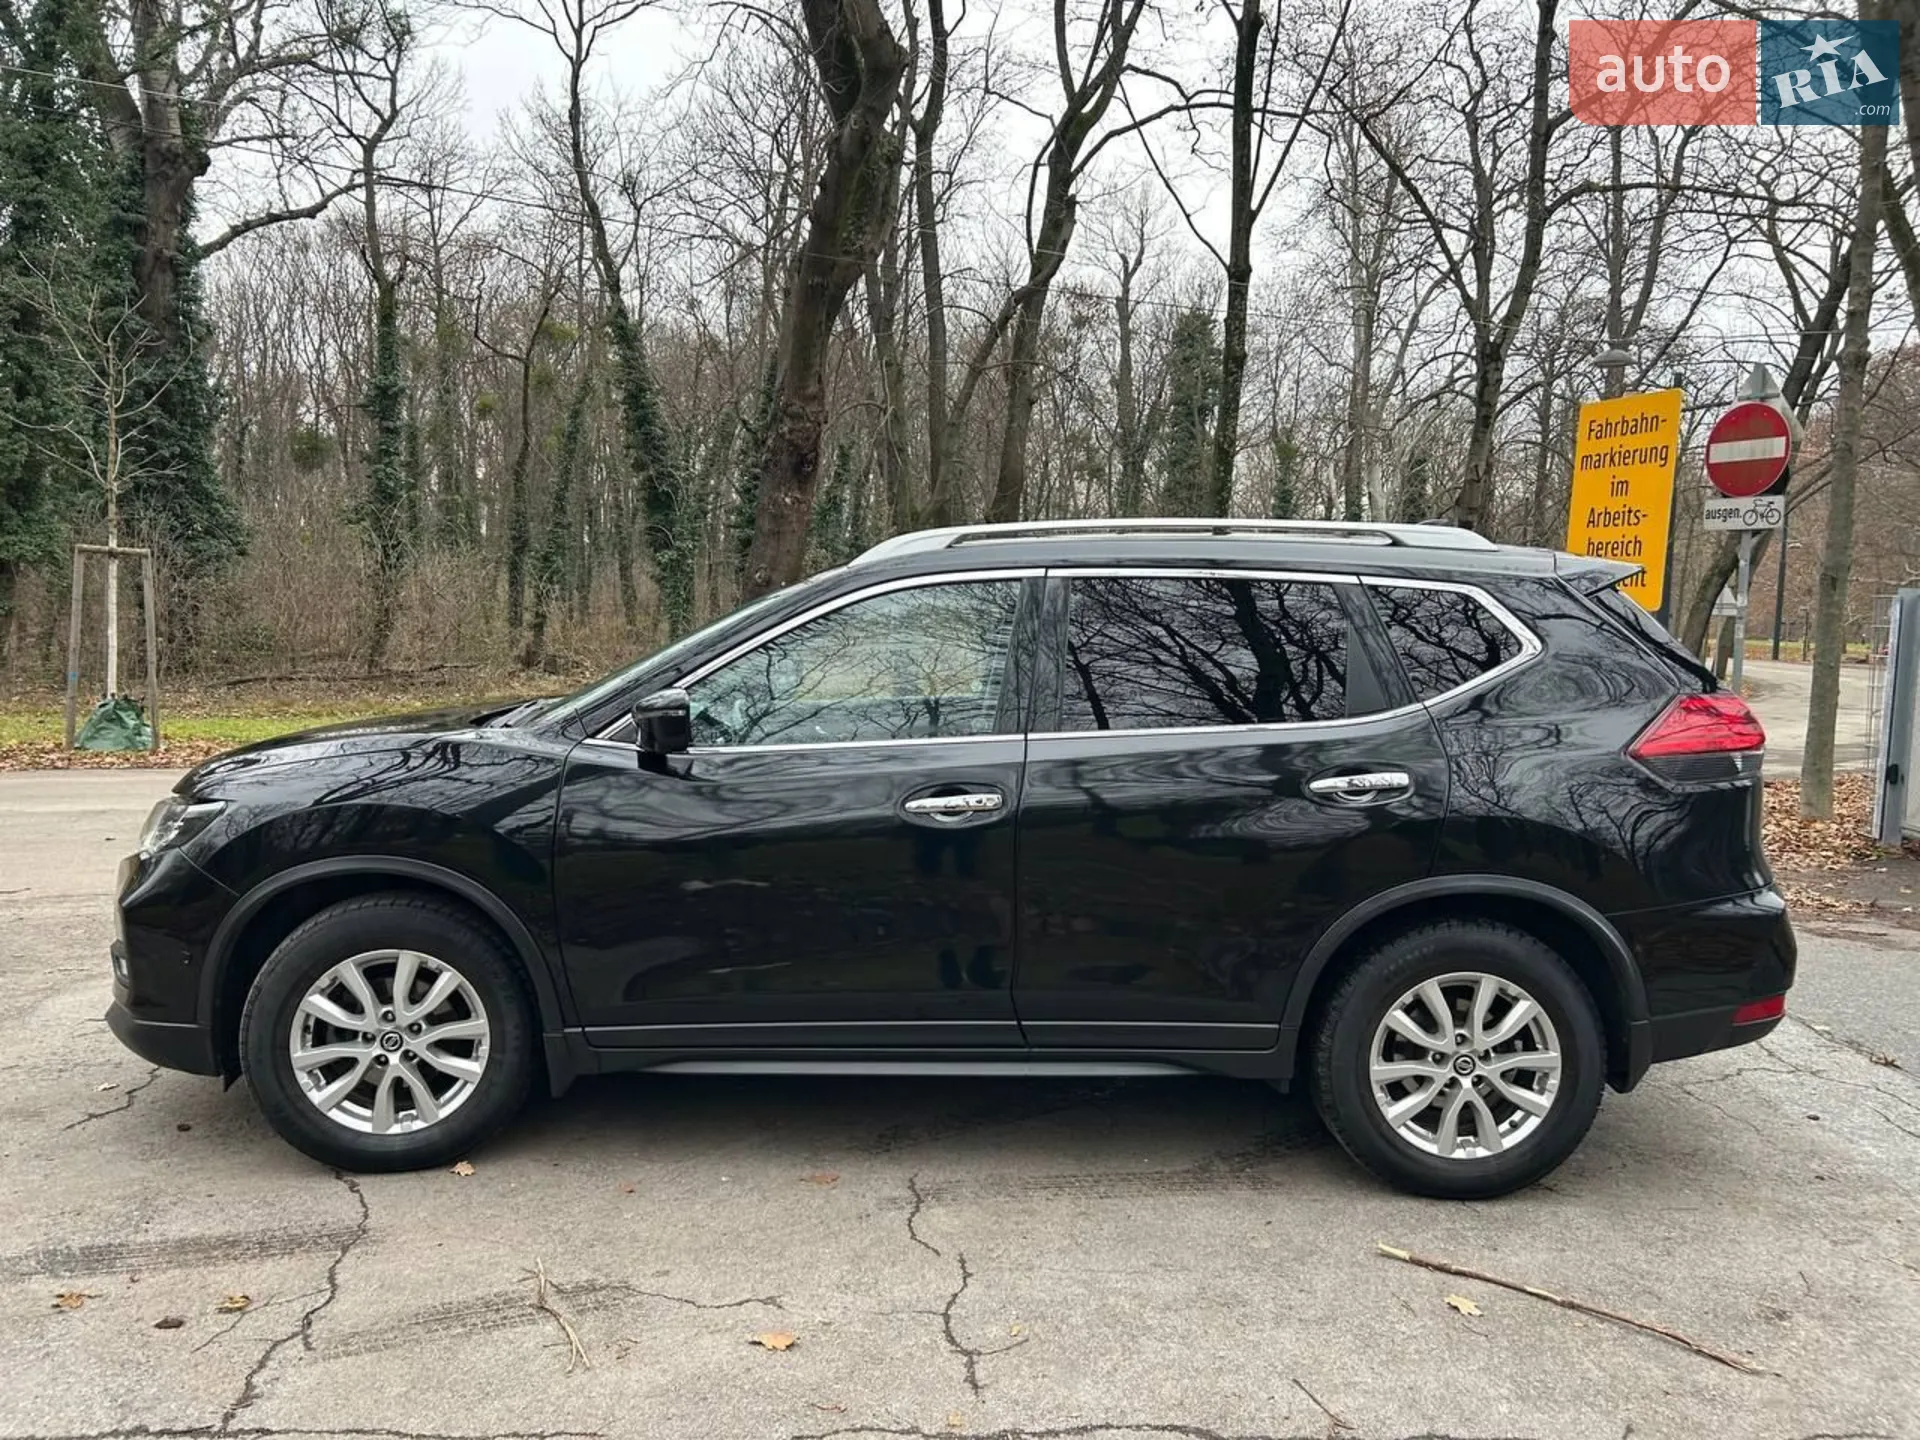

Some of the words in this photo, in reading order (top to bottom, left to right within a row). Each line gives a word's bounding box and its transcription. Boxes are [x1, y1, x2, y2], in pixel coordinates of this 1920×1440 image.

[1587, 412, 1667, 441] Fahrbahn-
[1580, 444, 1669, 472] markierung
[1610, 475, 1629, 497] im
[1586, 504, 1648, 529] Arbeits-
[1705, 507, 1742, 523] ausgen.
[1586, 534, 1643, 557] bereich
